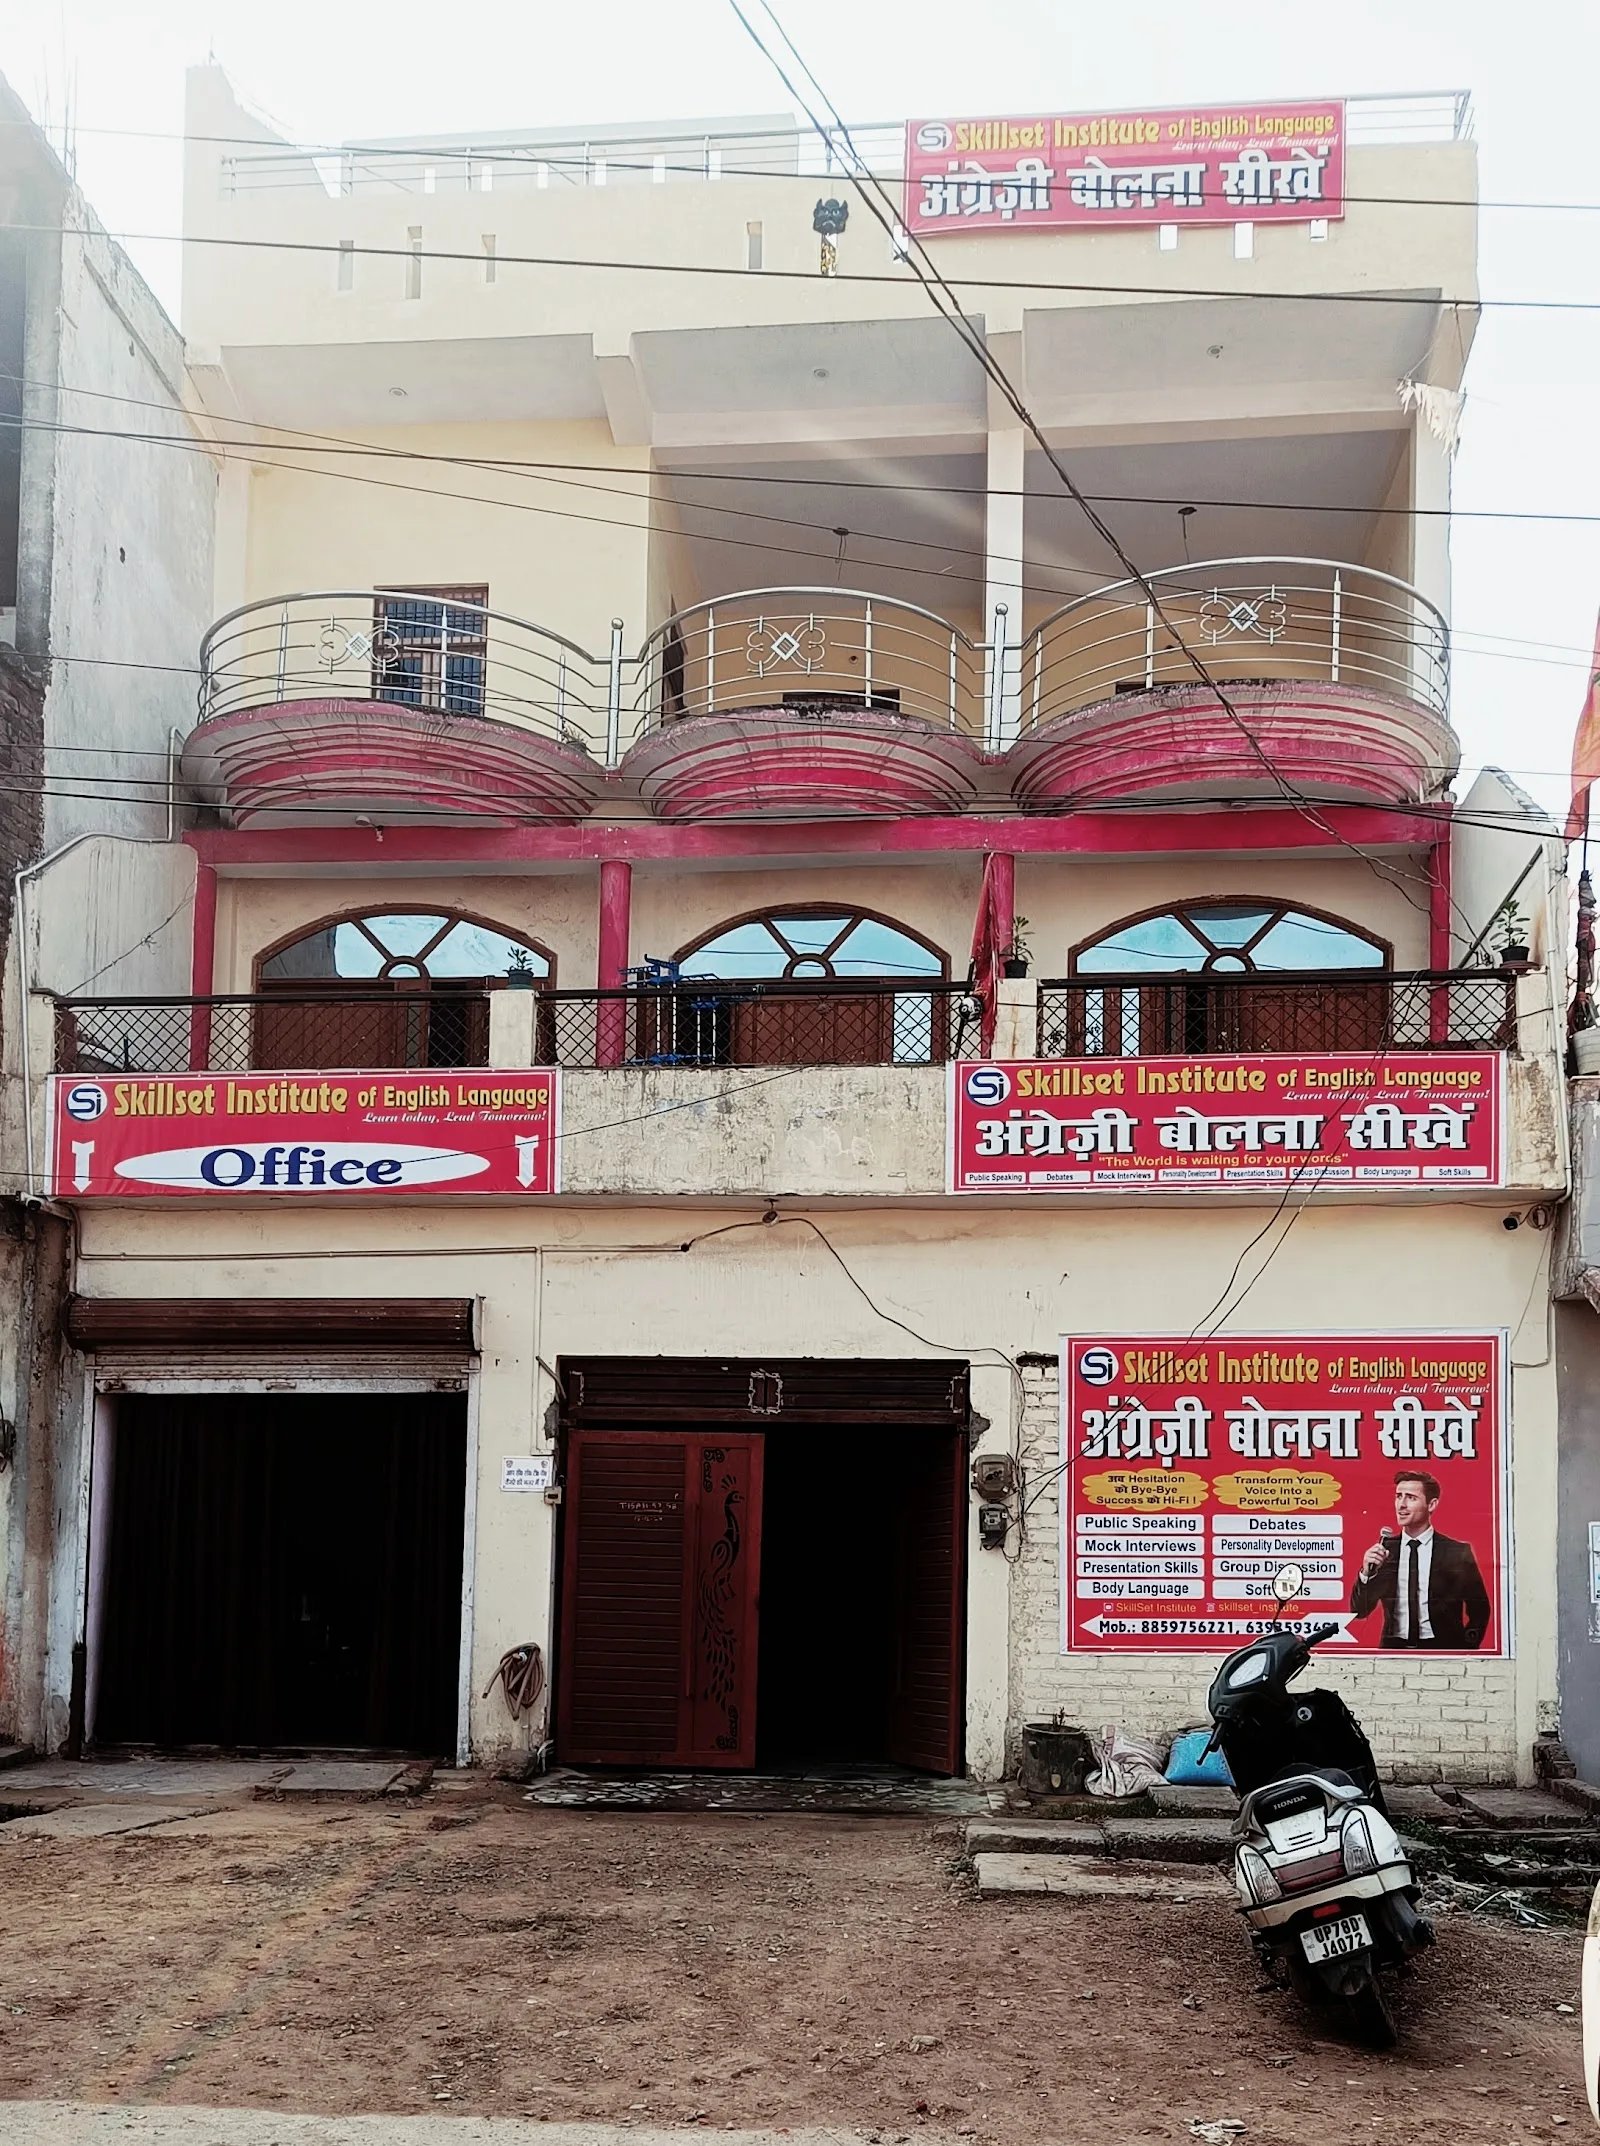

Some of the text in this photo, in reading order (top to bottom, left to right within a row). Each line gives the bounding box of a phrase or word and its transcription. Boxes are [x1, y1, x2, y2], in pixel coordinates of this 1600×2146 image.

[955, 114, 1335, 151] Skillset Institute of English Language
[1066, 156, 1207, 210] बोलना
[1219, 145, 1330, 204] सीखें
[1016, 1063, 1482, 1097] Skillset Institute of English Language
[113, 1081, 548, 1116] Skillset Institute of English Language
[1282, 1088, 1490, 1102] Learn today, Lead Tomorrow!
[361, 1109, 546, 1124] Learn today, Lead Tomorrow!
[1153, 1106, 1326, 1151] बोलना
[1341, 1102, 1478, 1150] सीखें
[199, 1147, 403, 1187] Office
[1099, 1156, 1130, 1167] "The
[1133, 1156, 1172, 1167] World
[1176, 1155, 1188, 1166] is
[1191, 1154, 1239, 1168] waiting
[1243, 1154, 1263, 1165] for
[1266, 1155, 1296, 1168] your
[969, 1173, 1023, 1183] Public Speaking
[1046, 1173, 1074, 1182] Debates
[1097, 1171, 1151, 1181] Mock Interviews
[1162, 1169, 1218, 1180] Personality Development
[1226, 1169, 1283, 1178] Presentation Skills
[1363, 1167, 1412, 1178] Body Language
[1438, 1167, 1472, 1177] Soft Skills
[1122, 1351, 1487, 1383] Skillset Institute of English Language
[1328, 1381, 1490, 1396] Learn today, Lead Tomorrow!
[1224, 1395, 1362, 1458] बोलना
[1374, 1395, 1482, 1458] सीखें
[1108, 1474, 1185, 1484] अब Hesitation
[1234, 1476, 1324, 1485] Transform Your
[1114, 1484, 1178, 1495] को Bye-Bye
[1245, 1486, 1278, 1495] Voice
[1096, 1495, 1144, 1505] Success
[1146, 1494, 1162, 1505] को
[1163, 1495, 1190, 1505] Hi-Fi
[1239, 1496, 1318, 1506] Powerful Tool
[1084, 1516, 1197, 1534] Public Speaking
[1248, 1518, 1307, 1531] Debates
[1084, 1539, 1196, 1552] Mock Interviews
[1221, 1538, 1335, 1553] Personality Development
[1083, 1560, 1199, 1574] Presentation Skills
[1220, 1560, 1337, 1575] Group Disssion
[1092, 1581, 1189, 1597] Body Language
[1245, 1583, 1272, 1596] Soft
[1116, 1602, 1197, 1613] SkillSet Institute
[1099, 1620, 1136, 1634] Mob.:
[1141, 1620, 1240, 1635] 8859756221,
[1273, 1794, 1308, 1811] HONDA
[1313, 1916, 1360, 1943] UP78D
[1321, 1931, 1367, 1959] J4072
